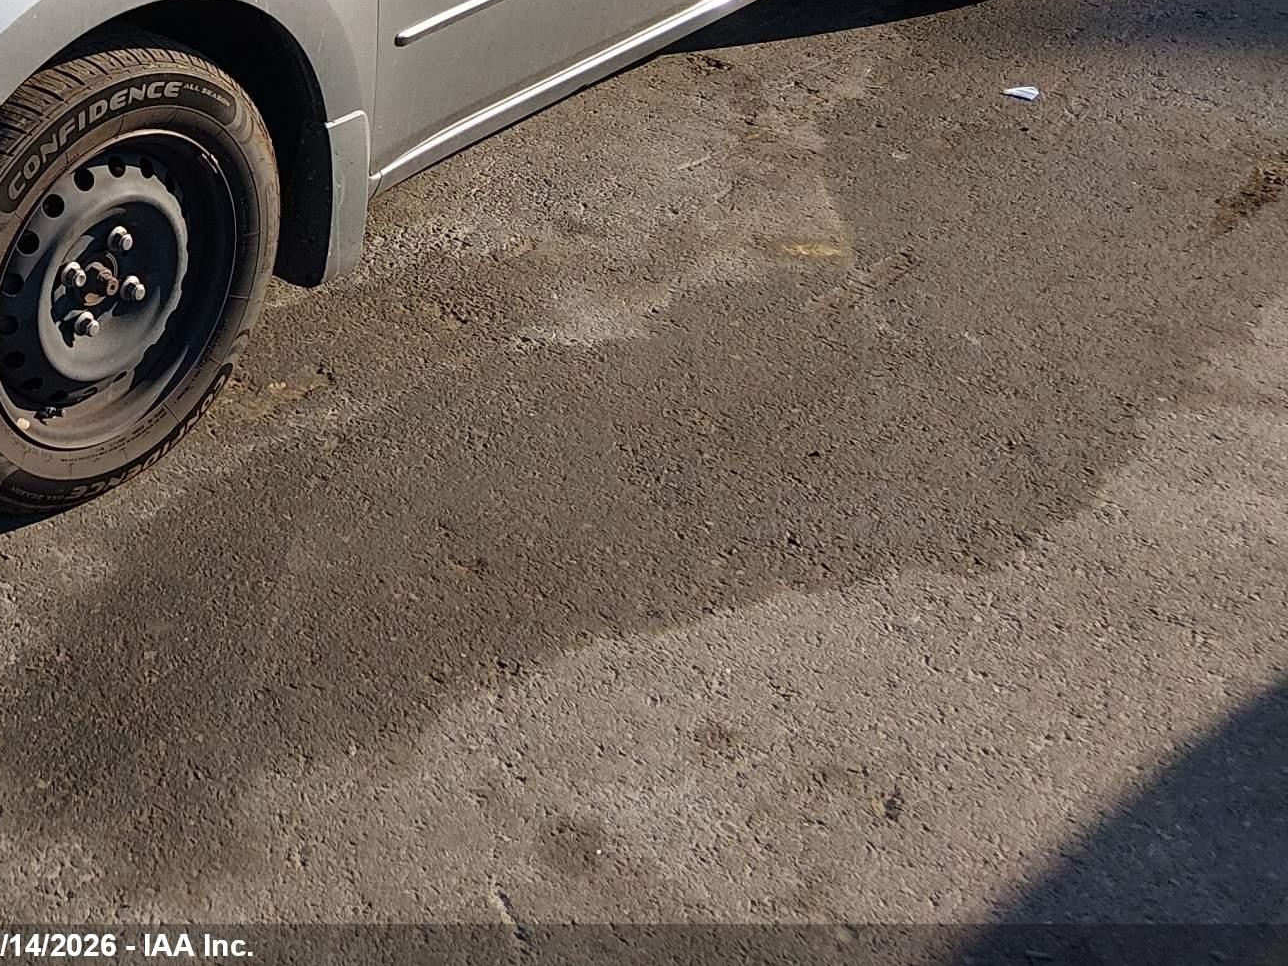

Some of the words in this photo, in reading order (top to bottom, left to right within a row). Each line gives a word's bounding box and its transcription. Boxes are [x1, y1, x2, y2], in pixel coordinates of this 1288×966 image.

[7, 81, 183, 201] CONFIDENCE
[183, 83, 201, 92] ALL
[201, 87, 231, 107] SEASON
